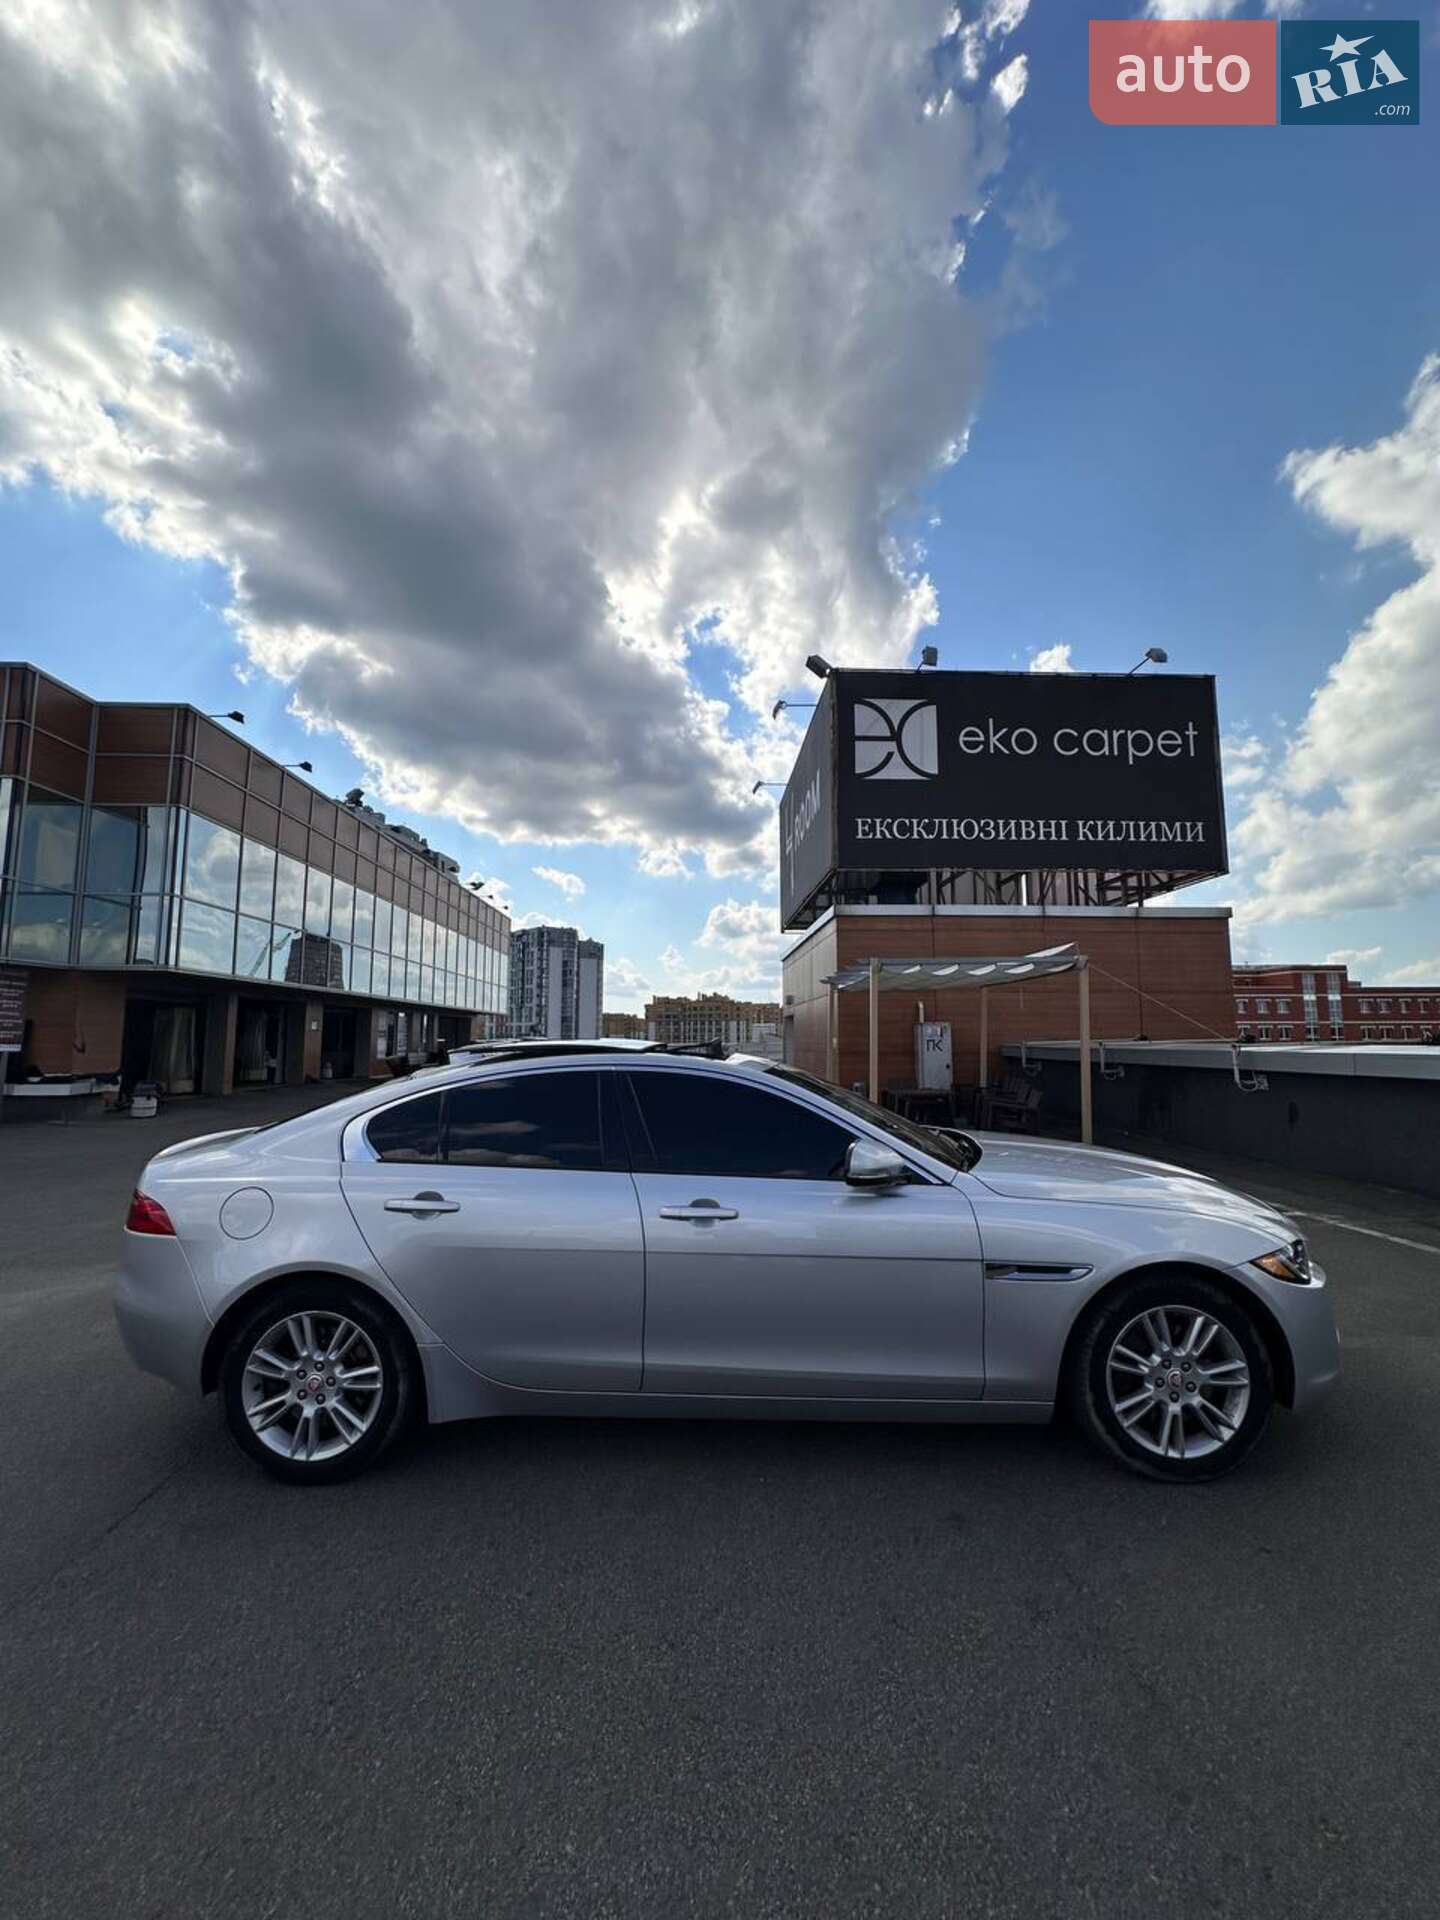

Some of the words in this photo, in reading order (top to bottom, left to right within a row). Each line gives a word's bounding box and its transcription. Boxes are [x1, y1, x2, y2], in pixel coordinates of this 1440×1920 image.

[959, 717, 1038, 756] eko
[1053, 721, 1199, 765] carpet
[855, 817, 1069, 841] ЕКСКЛЮЗИВНІ
[1077, 819, 1206, 843] КИЛИМИ
[926, 1039, 944, 1052] ПК
